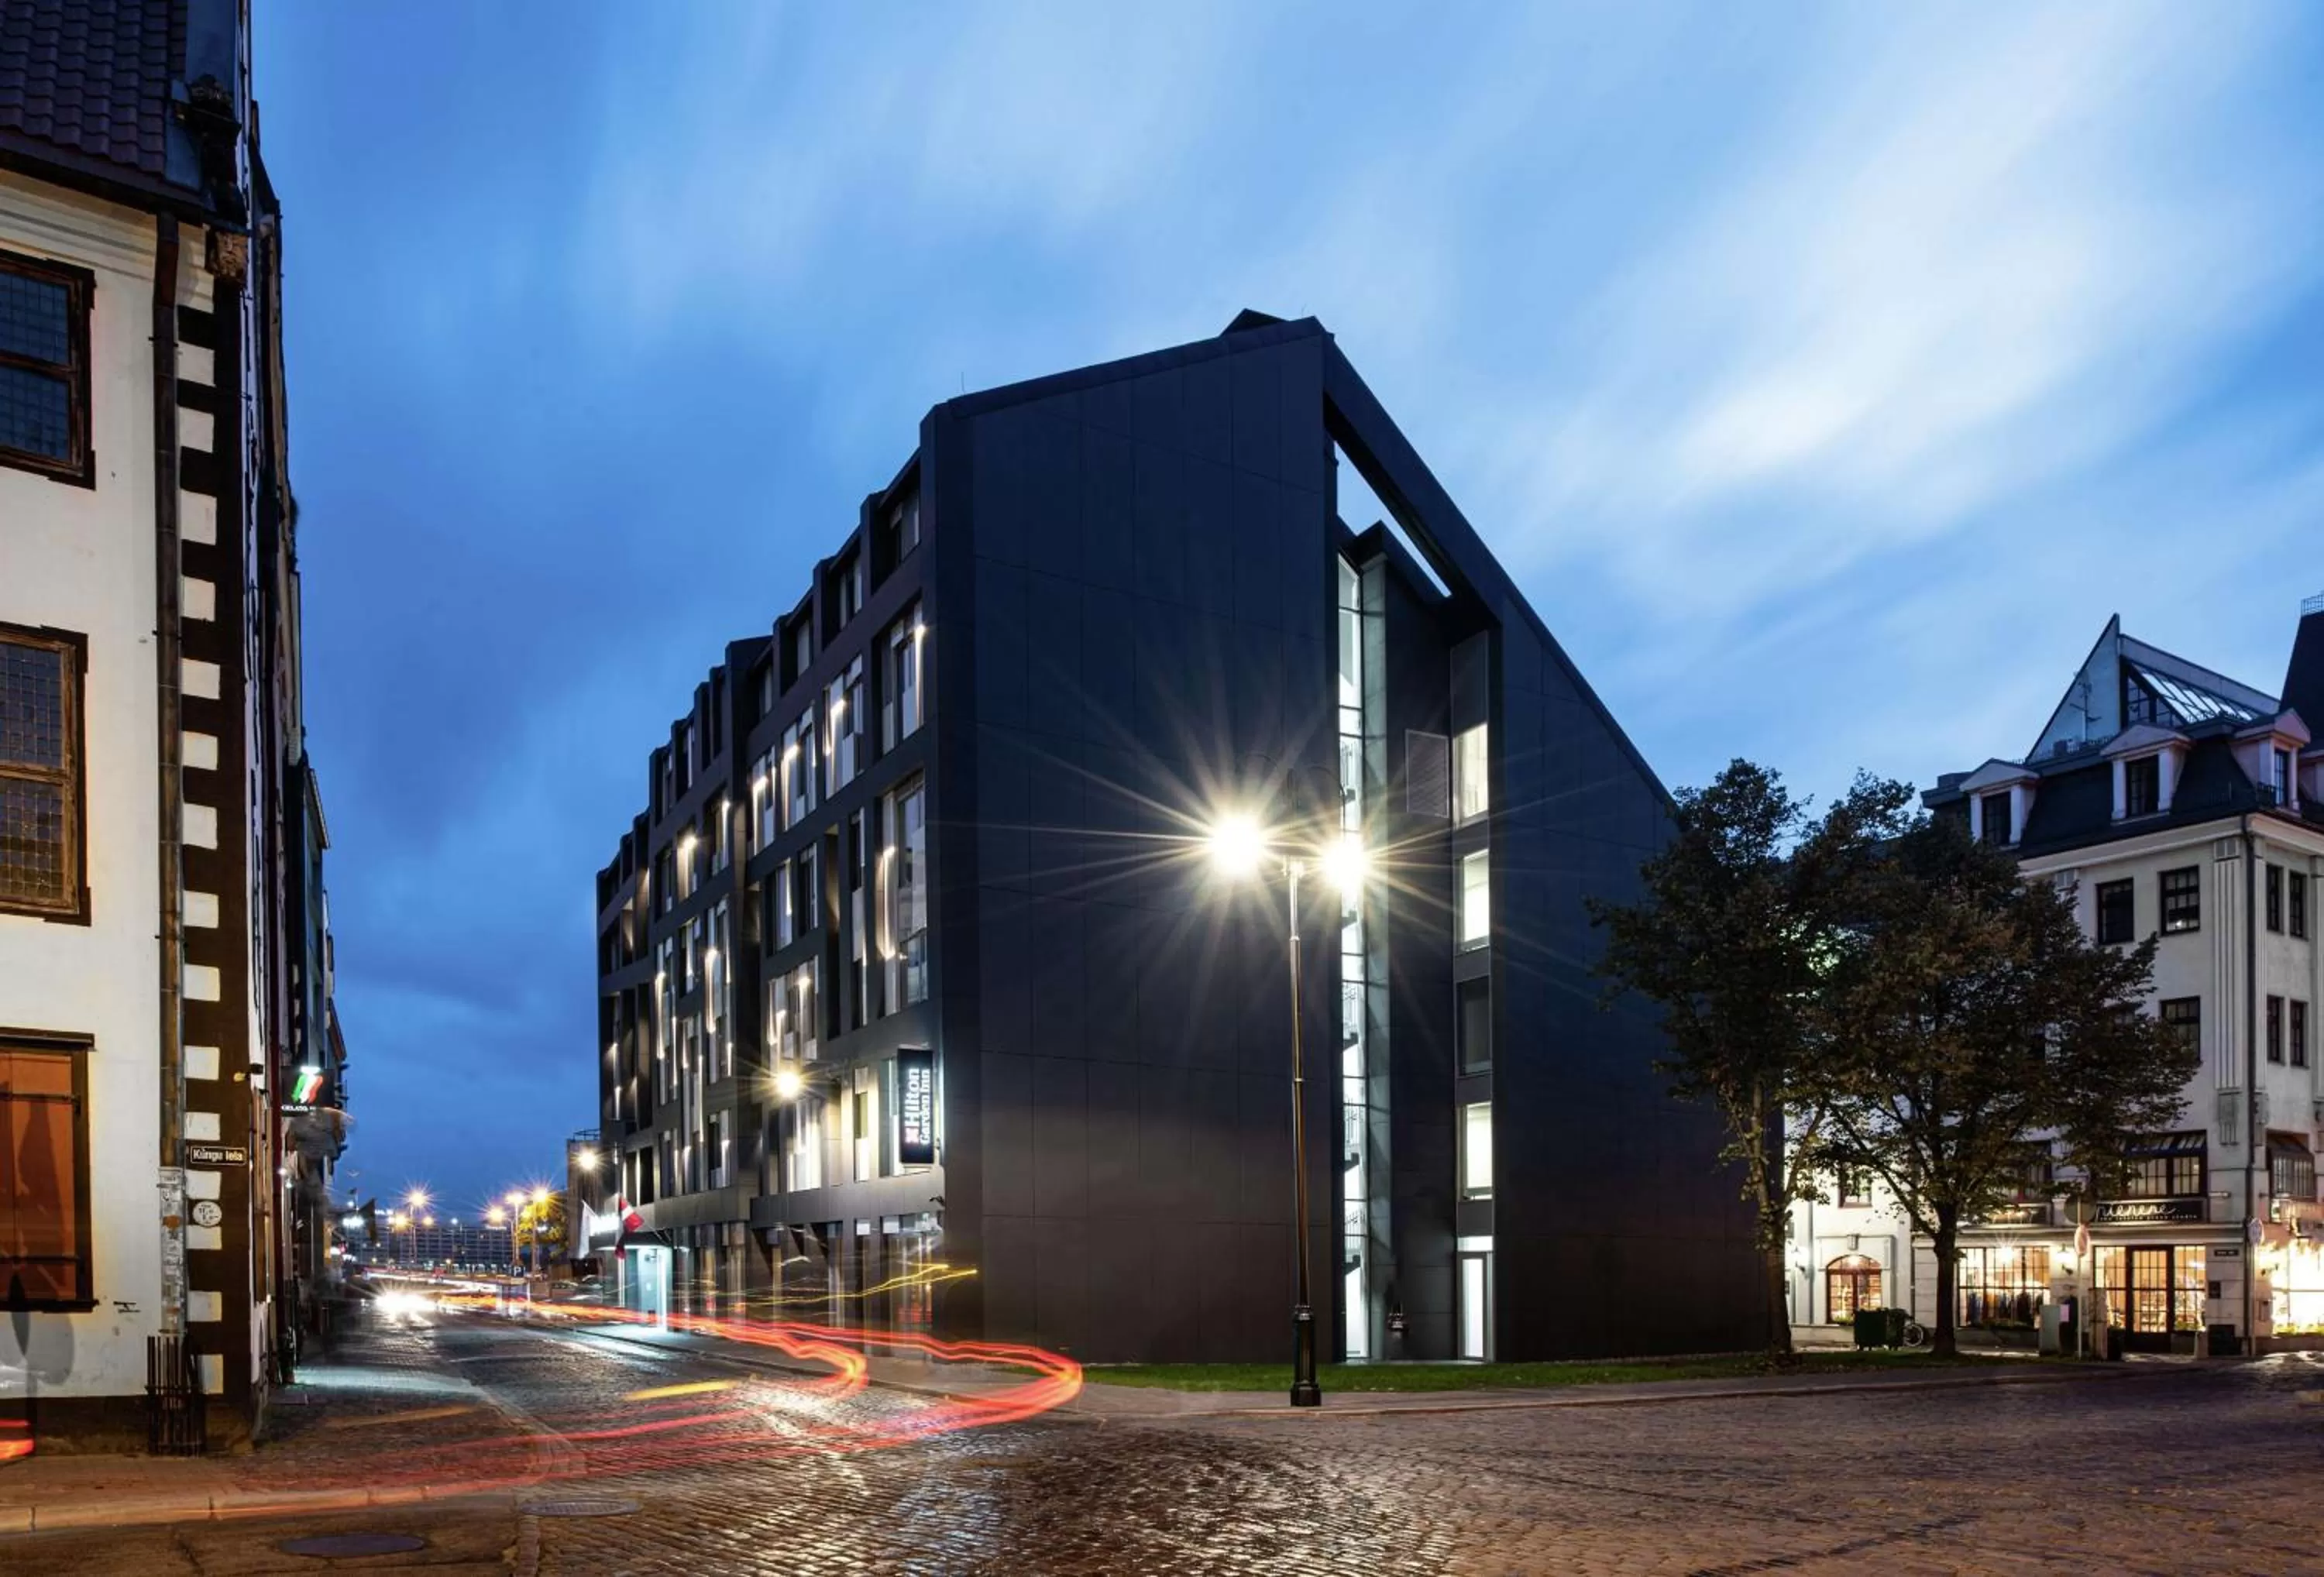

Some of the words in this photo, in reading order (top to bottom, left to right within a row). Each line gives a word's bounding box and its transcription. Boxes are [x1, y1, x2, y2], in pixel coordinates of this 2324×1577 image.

[904, 1068, 920, 1126] Hilton
[920, 1068, 930, 1093] Inn
[920, 1095, 930, 1145] Garden
